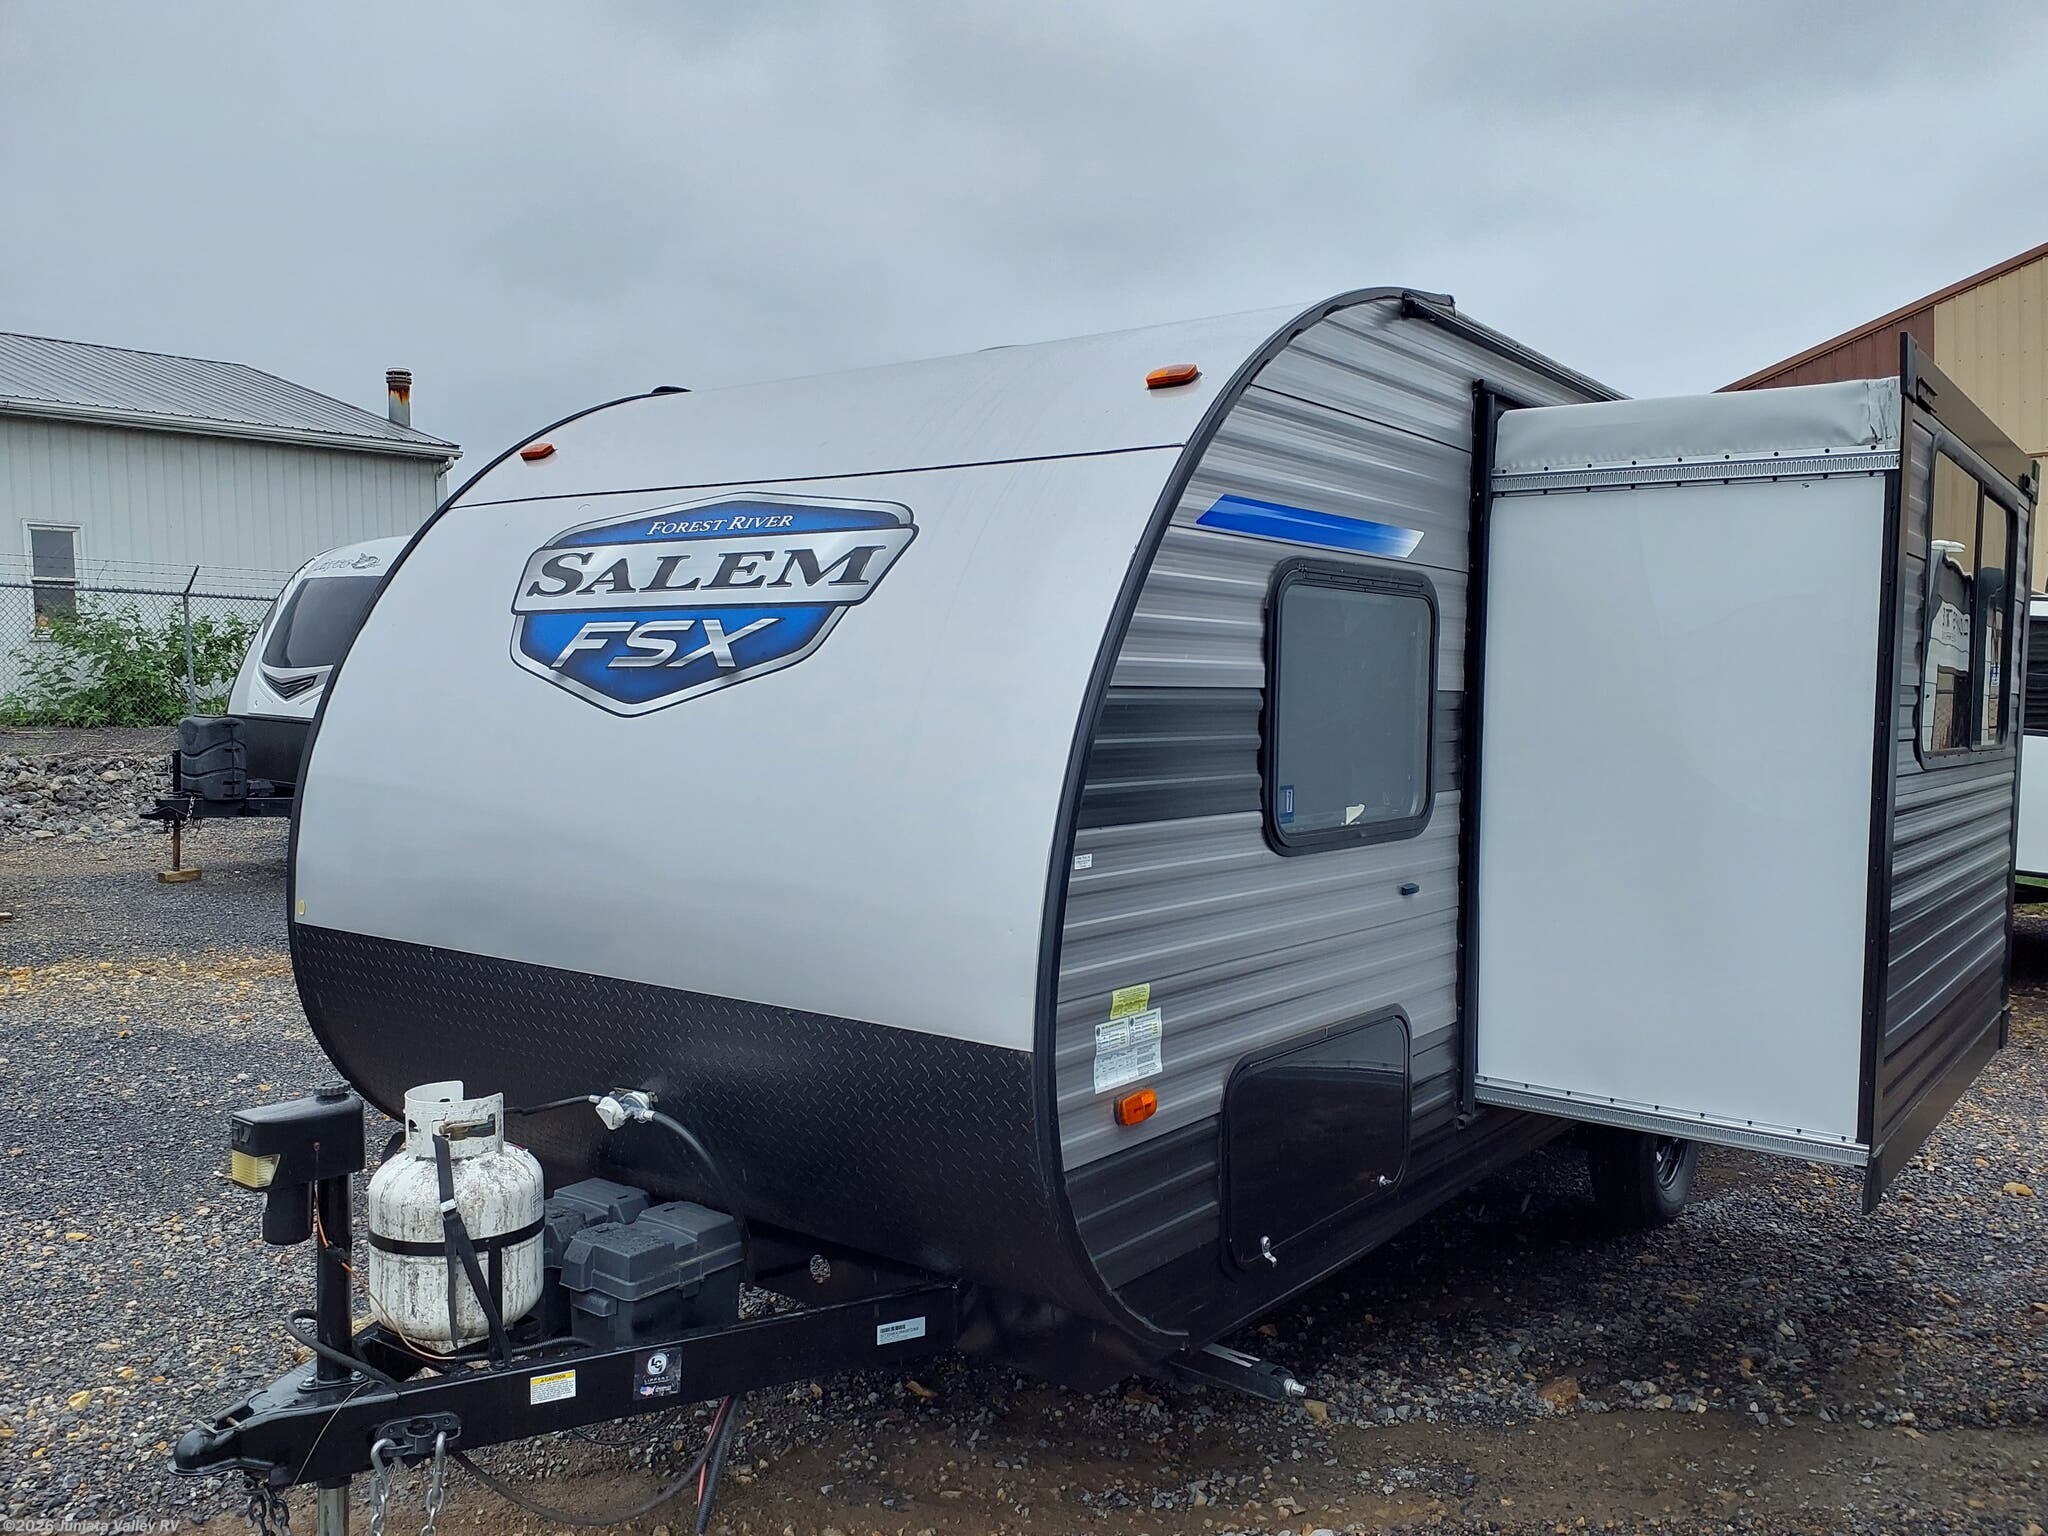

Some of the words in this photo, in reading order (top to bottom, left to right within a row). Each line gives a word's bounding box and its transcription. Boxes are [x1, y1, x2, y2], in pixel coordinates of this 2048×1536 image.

[525, 544, 887, 598] SALEM
[549, 616, 786, 669] FSX
[544, 1374, 567, 1383] CAUTION
